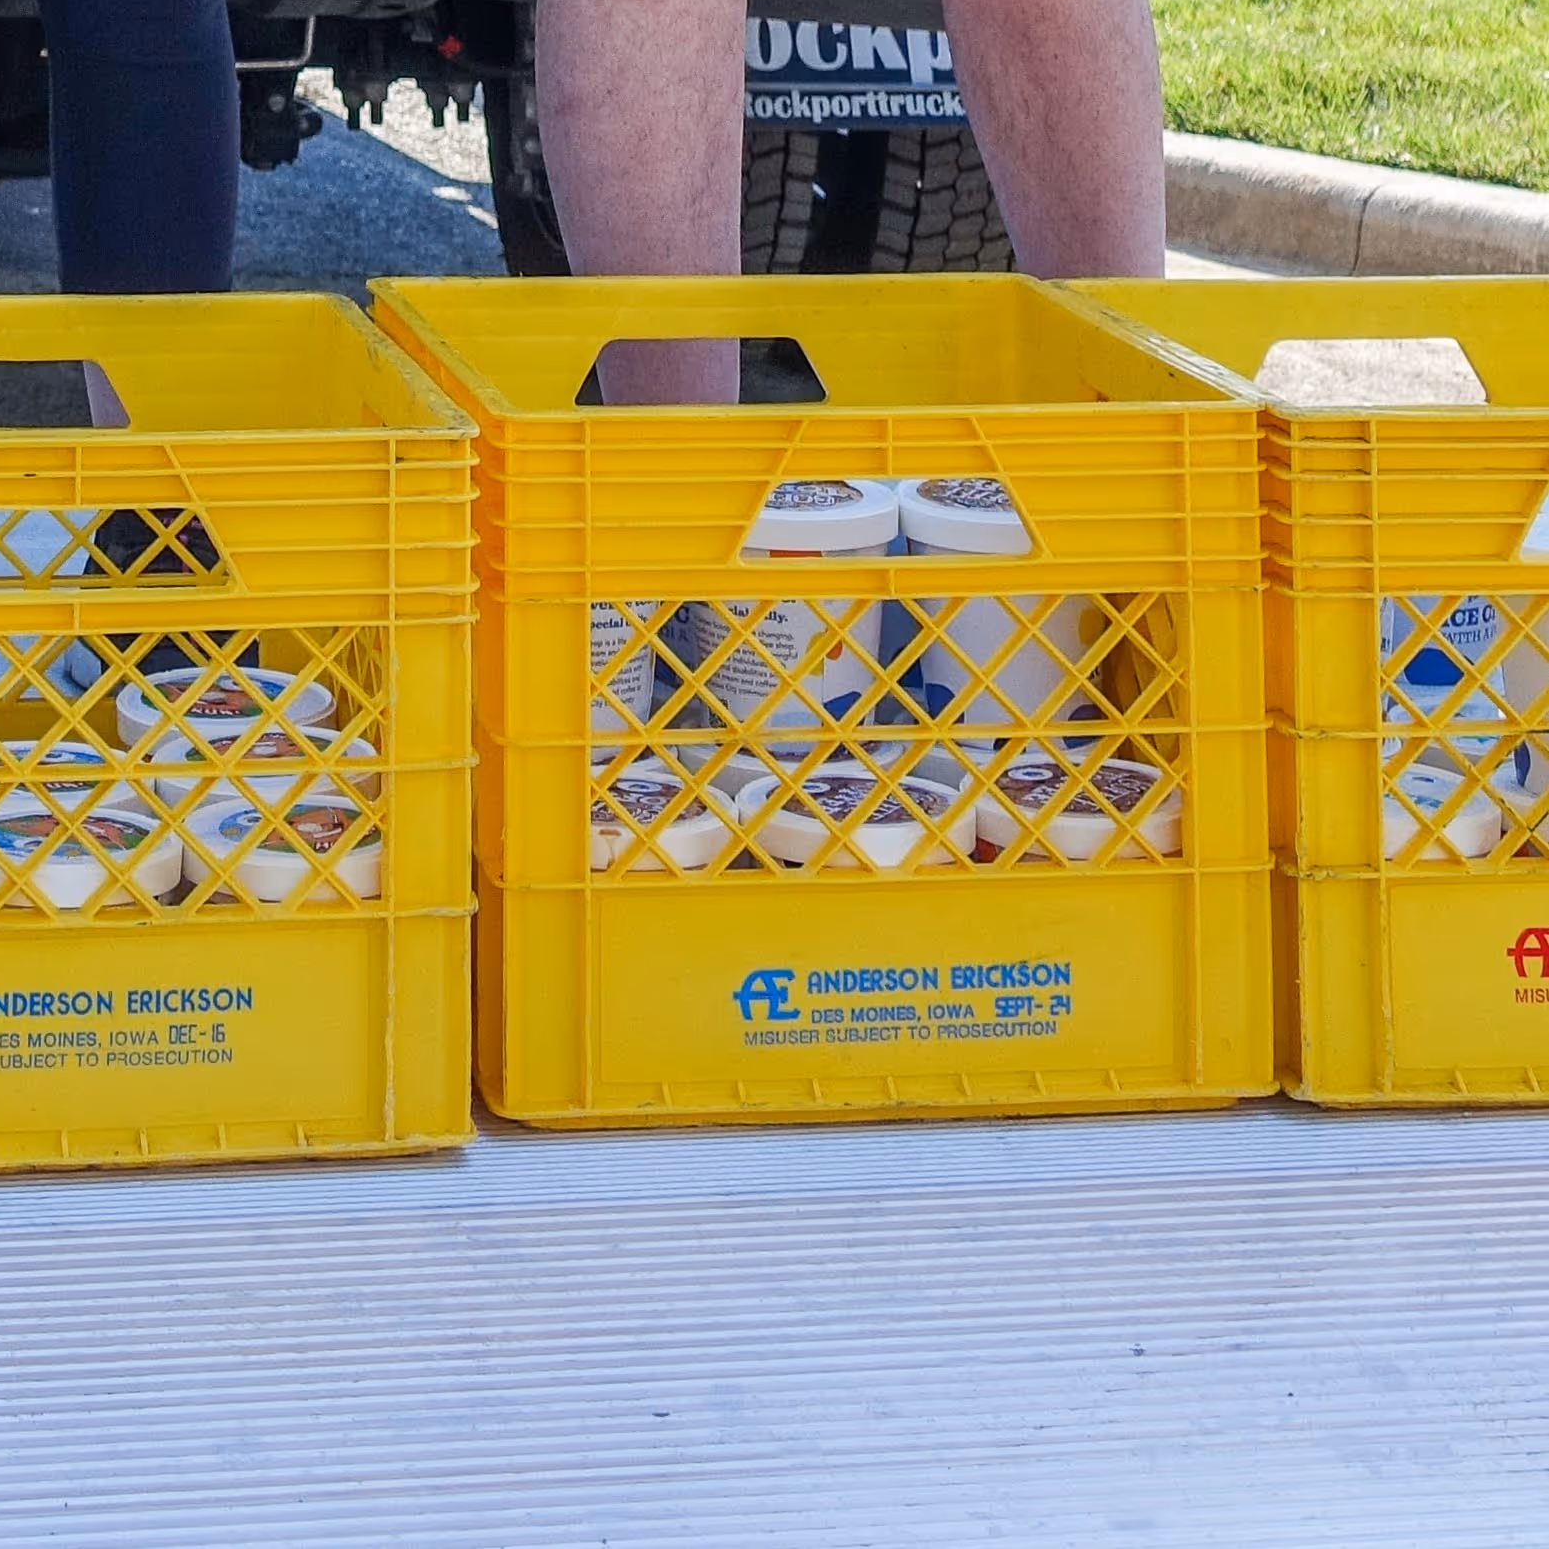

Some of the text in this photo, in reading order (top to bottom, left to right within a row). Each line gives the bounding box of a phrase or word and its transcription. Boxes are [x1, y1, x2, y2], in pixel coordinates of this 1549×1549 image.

[746, 16, 952, 86] ockp
[807, 967, 939, 994] ANDERSON
[950, 962, 1071, 989] ERICKSON
[127, 987, 252, 1014] ERICKSON
[811, 1009, 844, 1024] DES
[851, 1006, 921, 1022] MOINES,
[928, 1004, 975, 1020] IOWA
[27, 1031, 101, 1048] MOINES,
[109, 1031, 159, 1046] IOWA
[744, 1021, 1057, 1046] MISUSER SUBJECT TO PROSECUTION
[76, 1053, 99, 1067] TO
[106, 1048, 233, 1066] PROSECUTION
